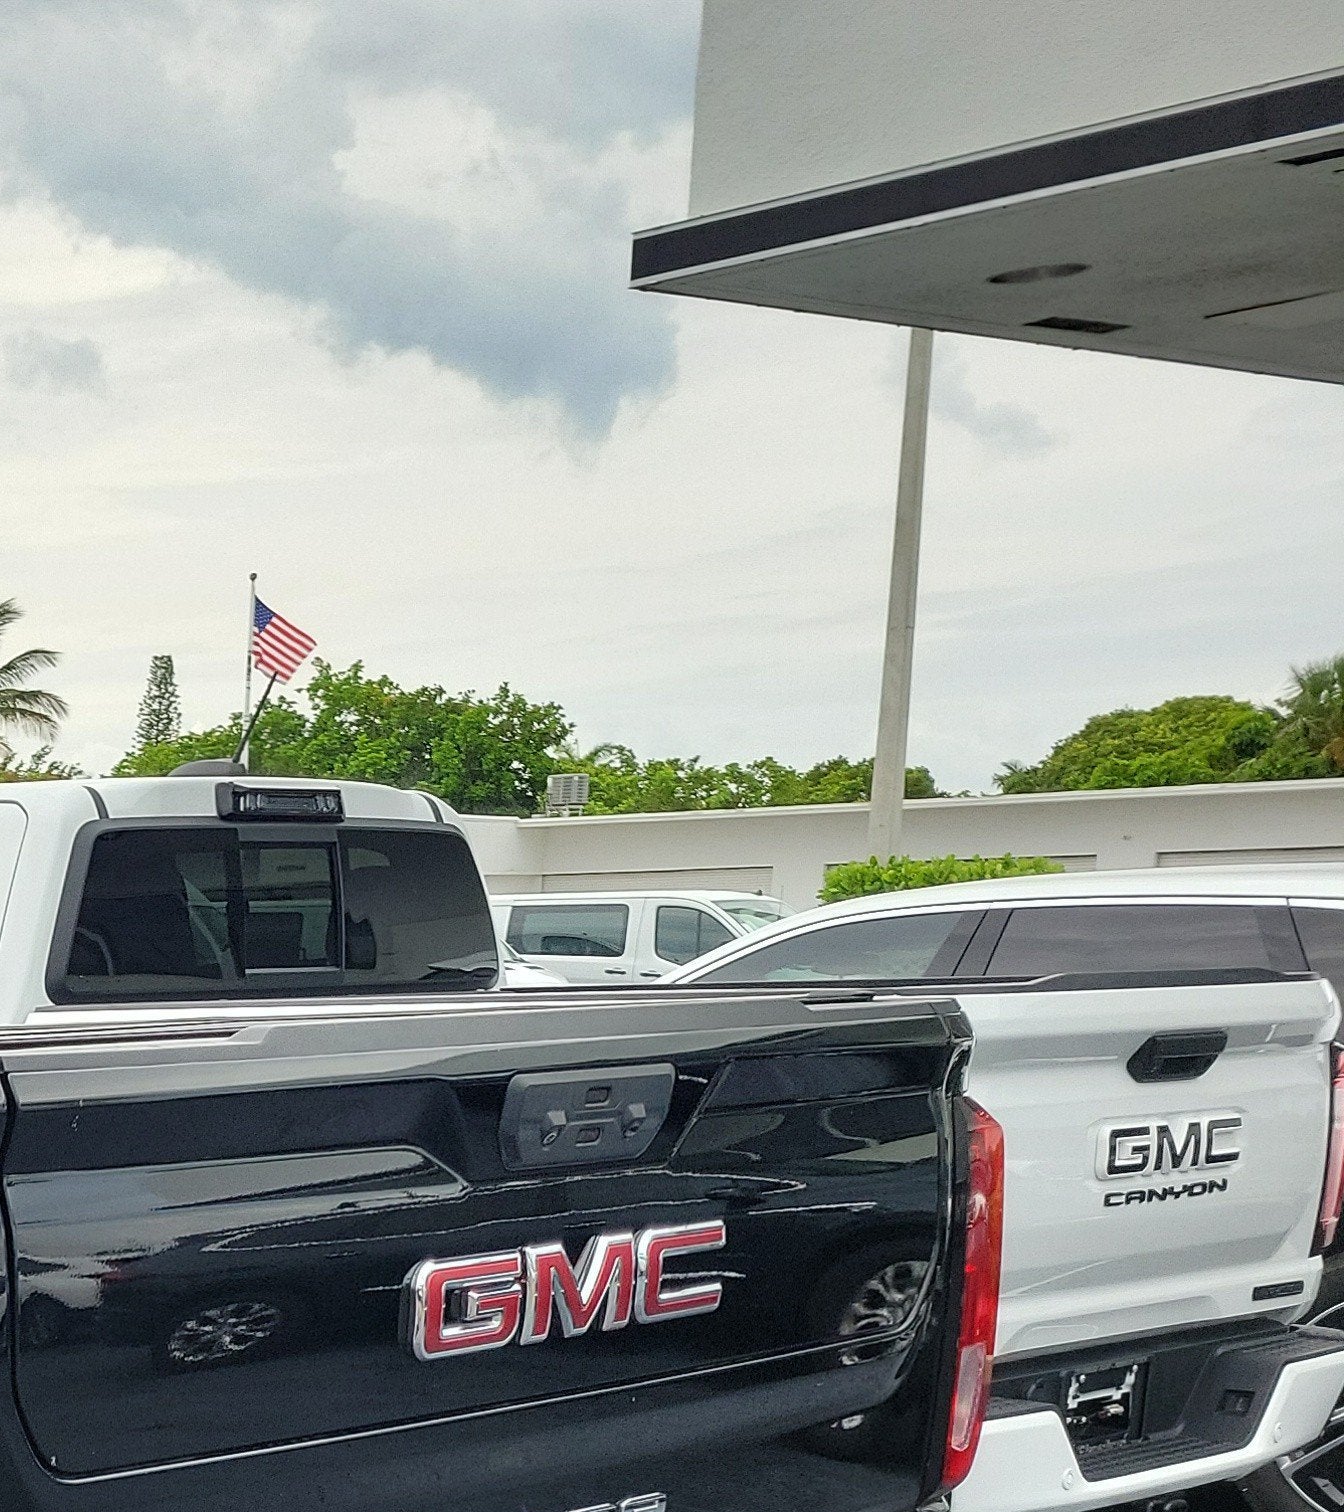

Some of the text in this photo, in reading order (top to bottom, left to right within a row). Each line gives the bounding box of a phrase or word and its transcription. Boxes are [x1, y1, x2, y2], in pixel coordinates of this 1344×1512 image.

[1106, 1117, 1242, 1176] GMC
[1103, 1178, 1228, 1207] CANYON
[411, 1220, 726, 1362] GMC
